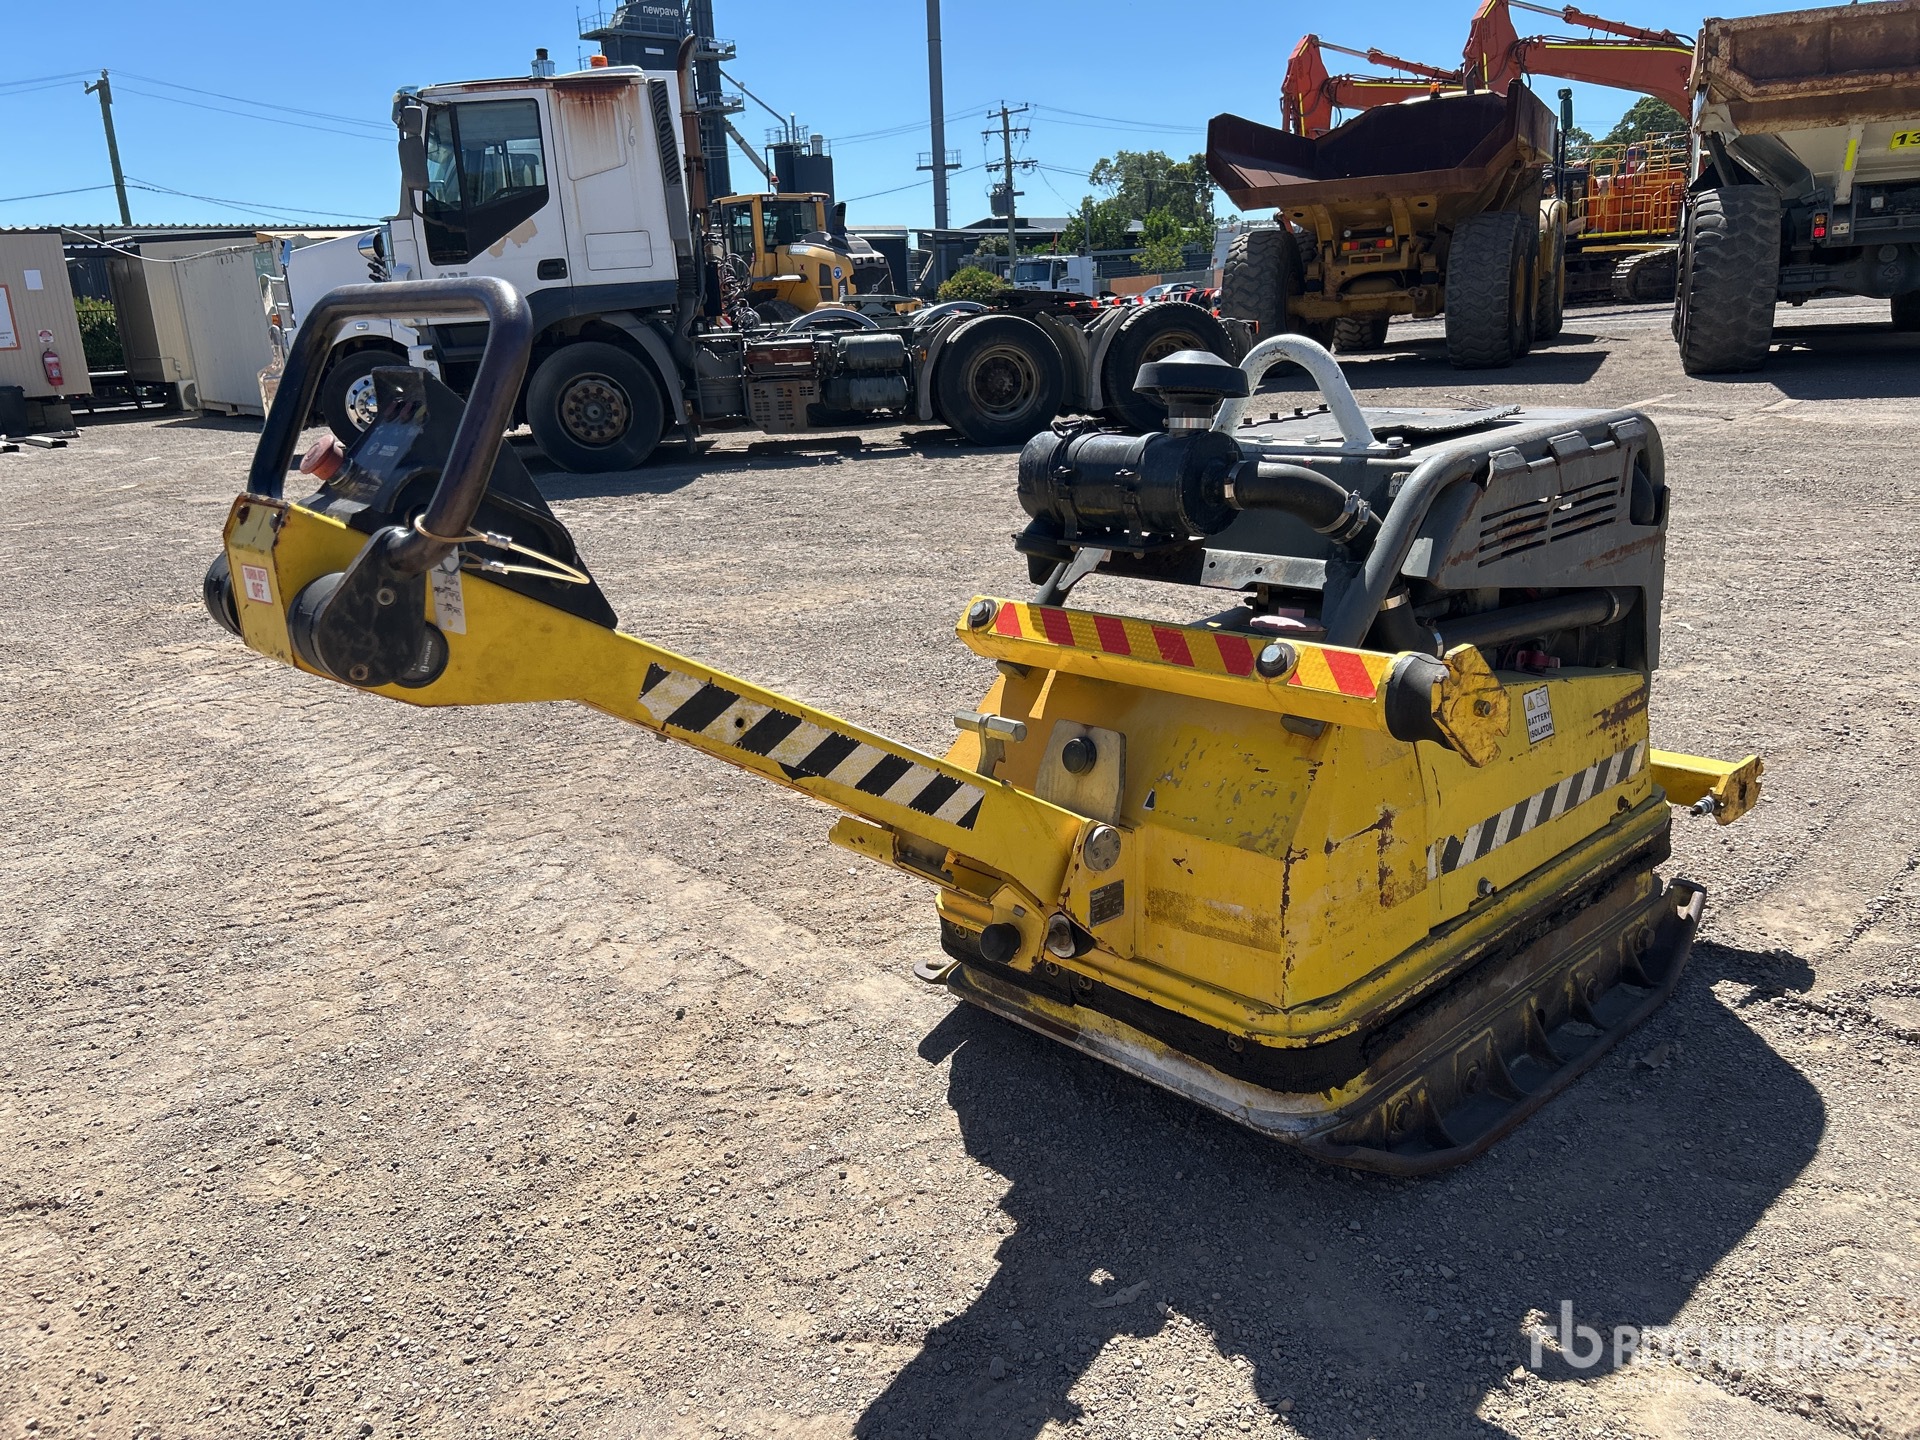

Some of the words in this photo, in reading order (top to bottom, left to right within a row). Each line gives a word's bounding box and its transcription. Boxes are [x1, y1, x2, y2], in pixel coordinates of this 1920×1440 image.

[642, 5, 680, 17] newpave
[252, 582, 265, 599] OFF
[1527, 710, 1551, 727] BATTERY
[1529, 722, 1553, 739] ISOLATOR
